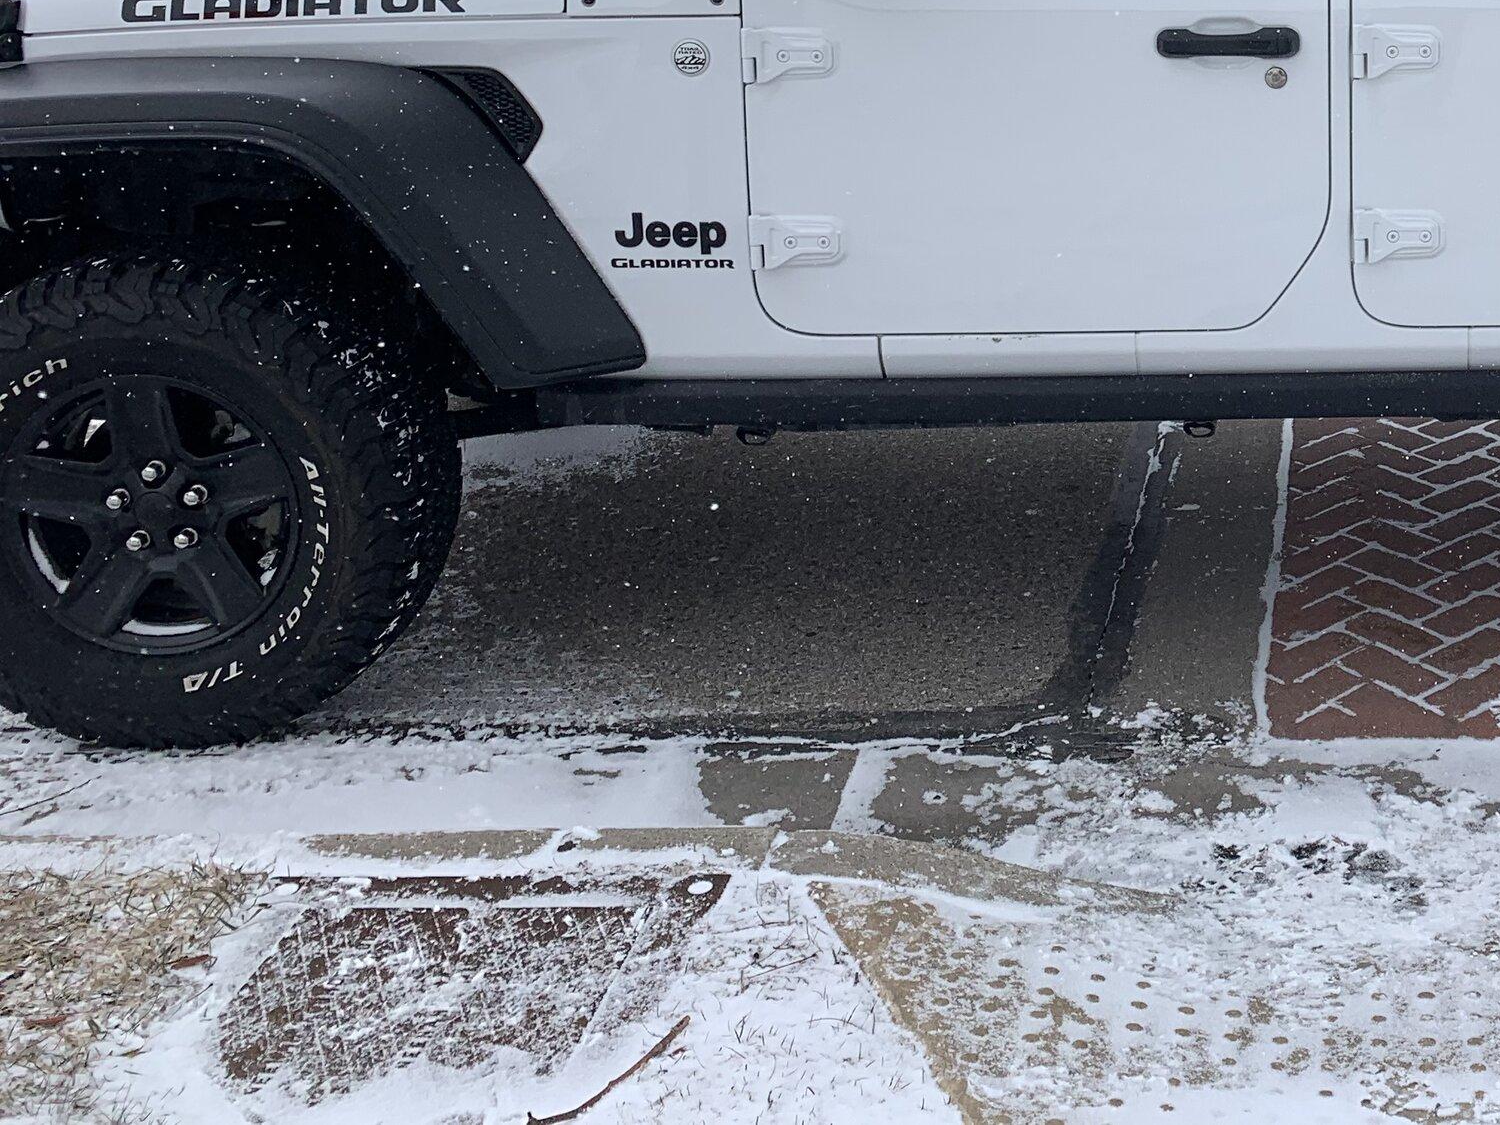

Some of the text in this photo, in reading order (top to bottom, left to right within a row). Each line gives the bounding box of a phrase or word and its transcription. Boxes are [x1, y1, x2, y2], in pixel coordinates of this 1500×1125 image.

[614, 212, 727, 255] Jeep
[610, 258, 735, 270] GLADIATOR
[259, 456, 330, 656] All-Terrain
